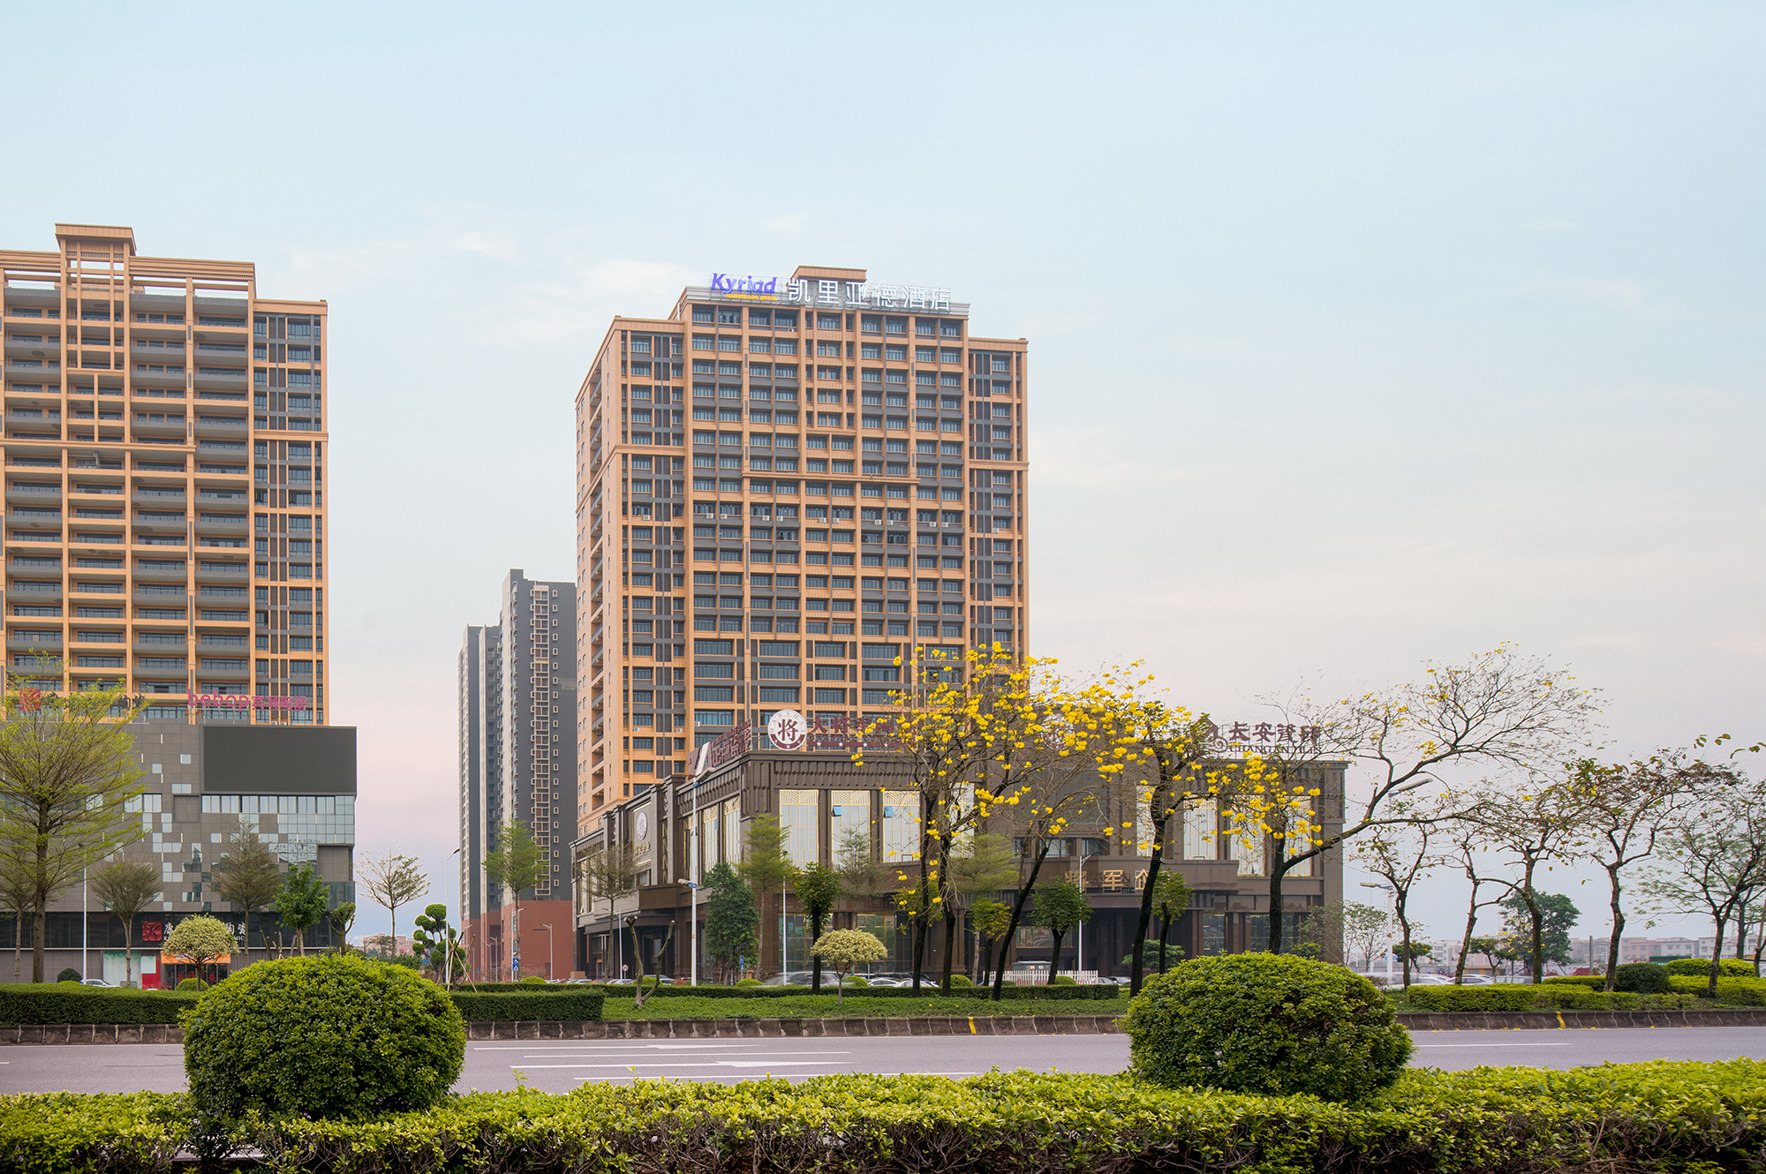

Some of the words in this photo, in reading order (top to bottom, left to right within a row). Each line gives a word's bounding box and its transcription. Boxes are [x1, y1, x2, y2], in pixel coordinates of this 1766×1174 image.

[711, 272, 778, 294] Kyriad
[787, 277, 952, 311] 凯里亚德酒店
[188, 688, 250, 712] bebop
[777, 718, 799, 742] 将
